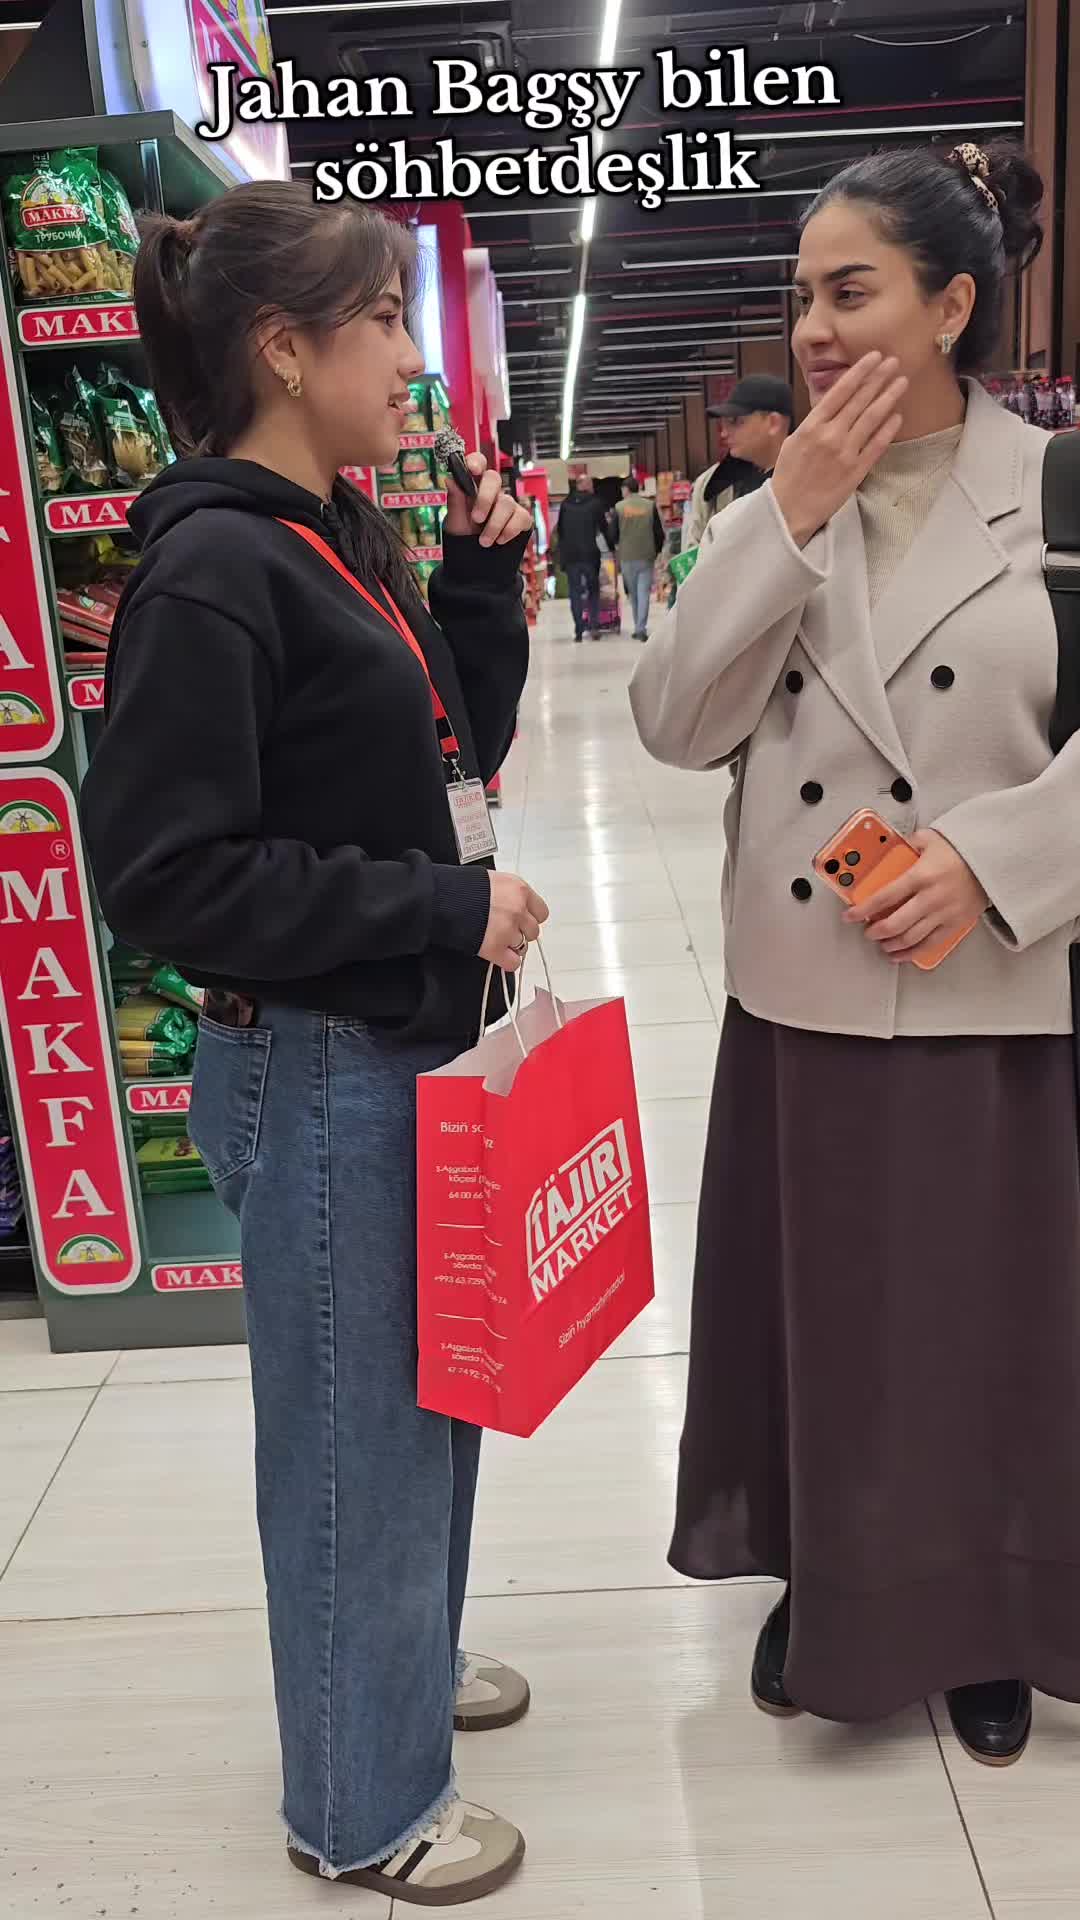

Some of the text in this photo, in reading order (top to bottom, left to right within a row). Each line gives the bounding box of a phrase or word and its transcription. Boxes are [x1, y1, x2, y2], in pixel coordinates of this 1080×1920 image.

[33, 310, 140, 338] MAK
[387, 495, 443, 505] MAKFA
[0, 867, 115, 1219] MAKFA
[530, 1179, 632, 1304] MARKET
